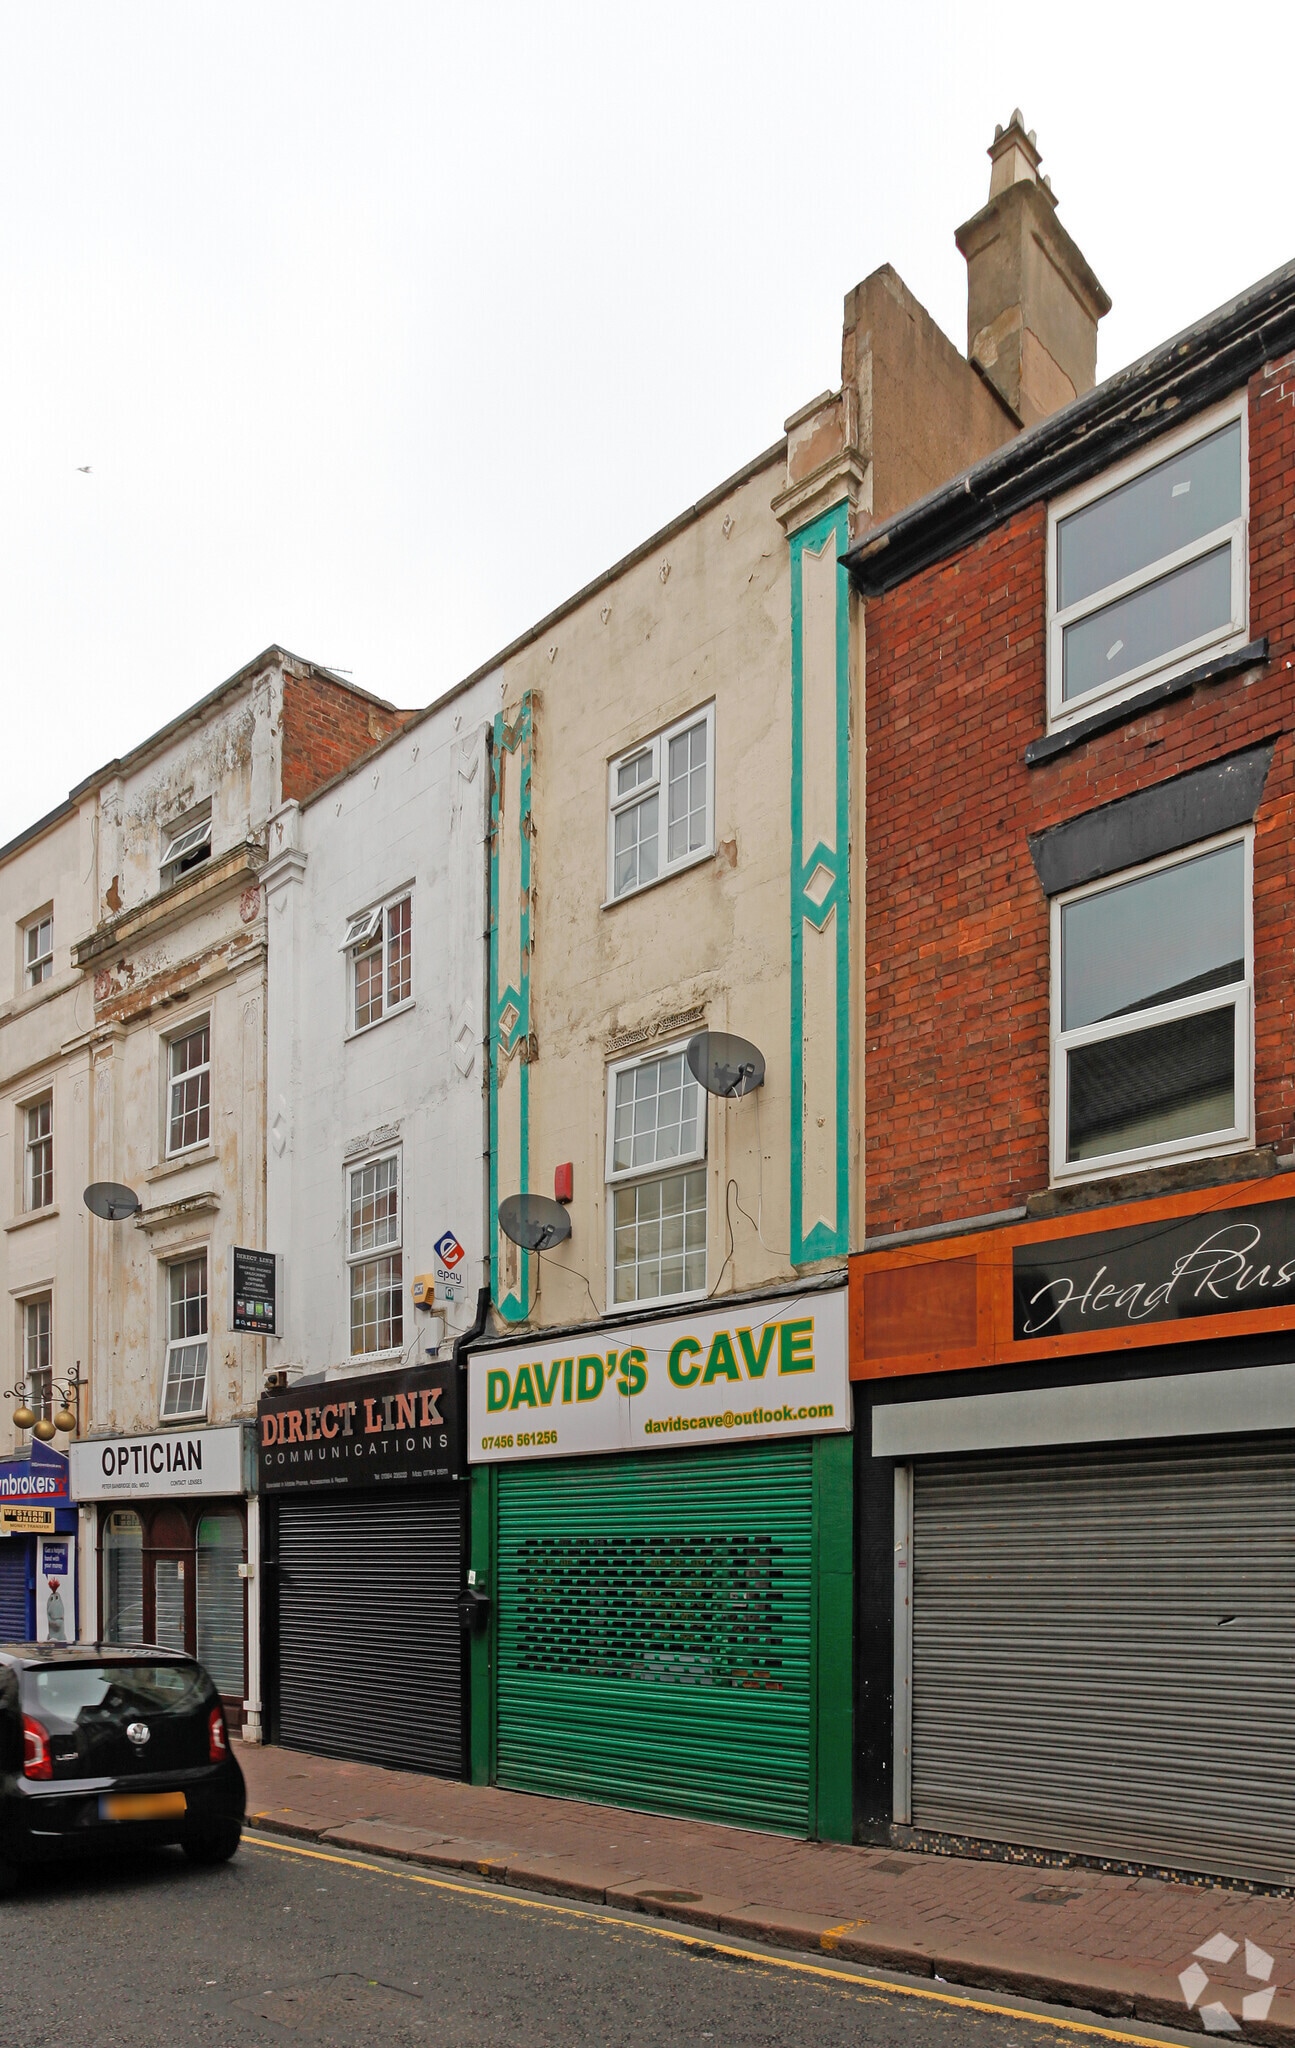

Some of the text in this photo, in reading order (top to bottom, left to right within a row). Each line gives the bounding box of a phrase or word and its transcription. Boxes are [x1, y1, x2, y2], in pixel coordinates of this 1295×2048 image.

[236, 1253, 258, 1262] DIRECT
[437, 1269, 462, 1284] epay
[1023, 1265, 1178, 1333] Head
[486, 1316, 816, 1414] DAVID'S CAVE
[261, 1387, 444, 1447] DIRECT LINK
[644, 1403, 835, 1434] davidscave@outlook.com
[265, 1434, 449, 1466] COMMUNICATIONS
[481, 1430, 559, 1451] 07456 561256
[101, 1439, 202, 1477] OPTICIAN
[0, 1473, 56, 1496] nbrokers
[170, 1478, 203, 1487] CONTACT LENSES
[4, 1509, 44, 1517] WESTERN
